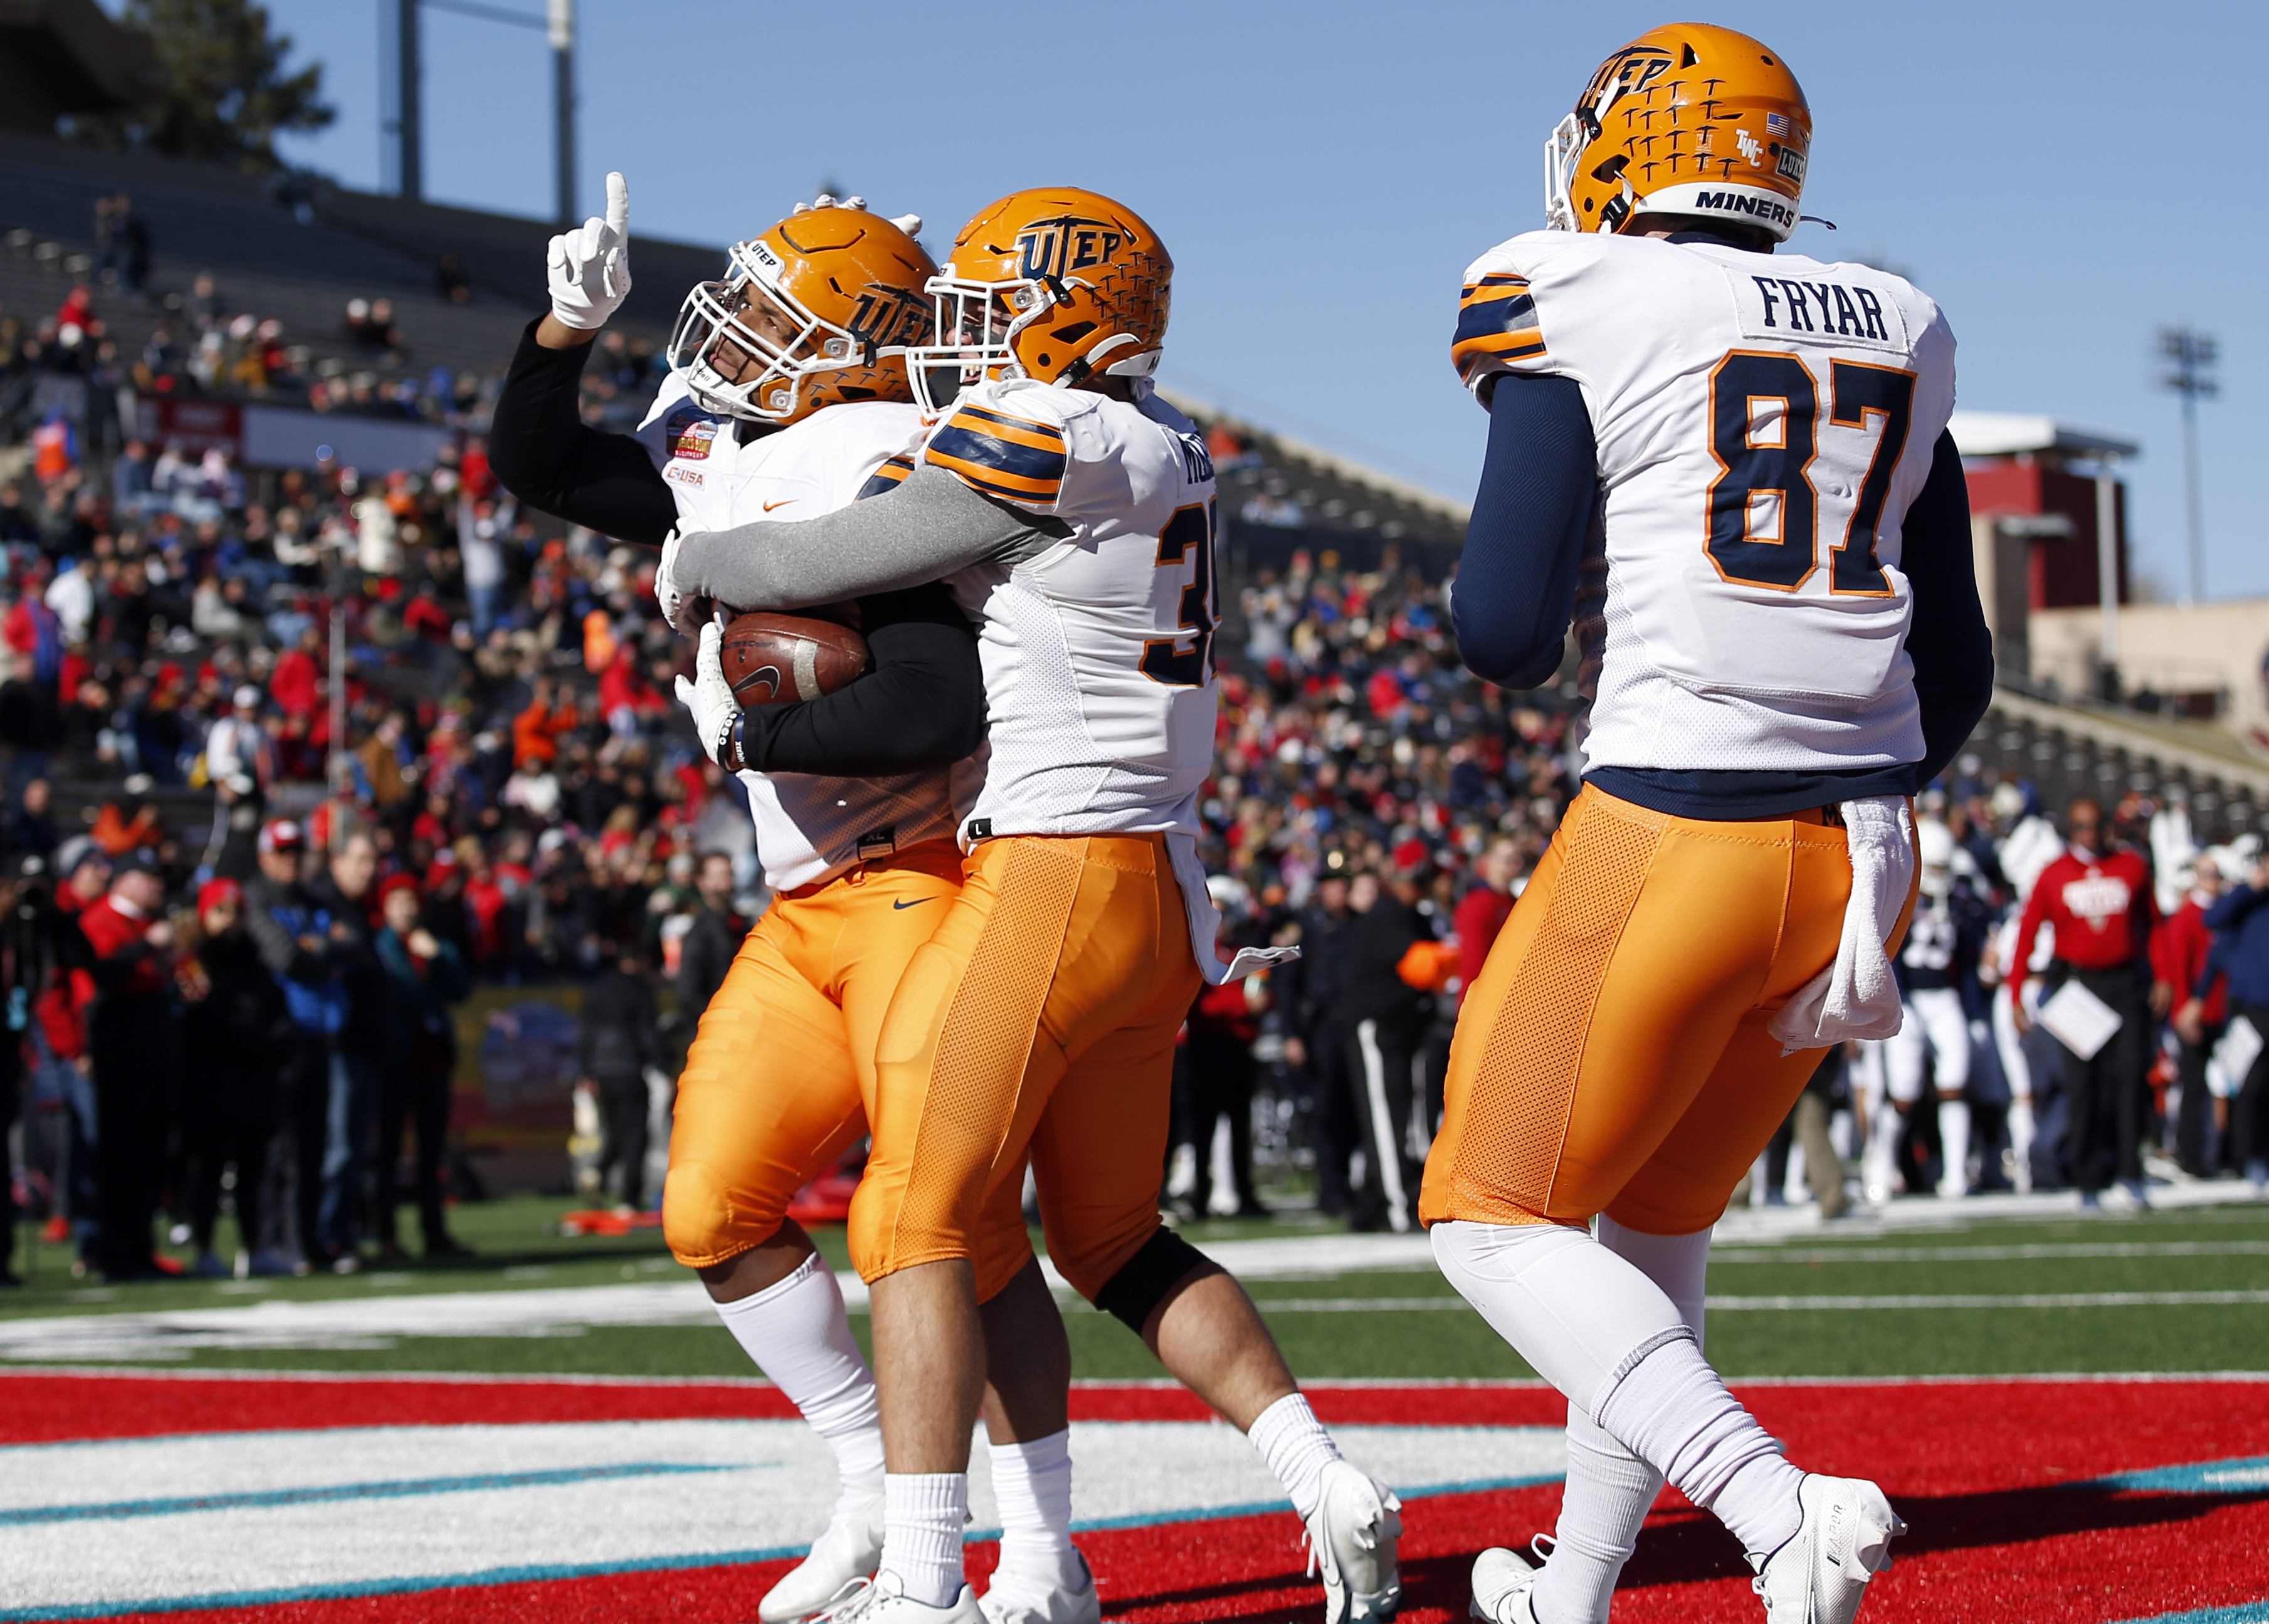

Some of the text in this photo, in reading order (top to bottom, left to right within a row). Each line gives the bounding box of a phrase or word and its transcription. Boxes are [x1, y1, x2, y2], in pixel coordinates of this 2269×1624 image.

[1736, 128, 1764, 167] TWC
[1695, 191, 1794, 228] MINERS
[752, 243, 777, 266] UTEP
[1018, 215, 1121, 281] UTEP
[849, 283, 934, 347] UTEP
[1751, 276, 1888, 340] FRYAR
[1702, 348, 1918, 598] 87
[866, 832, 885, 842] XL
[976, 823, 982, 835] L
